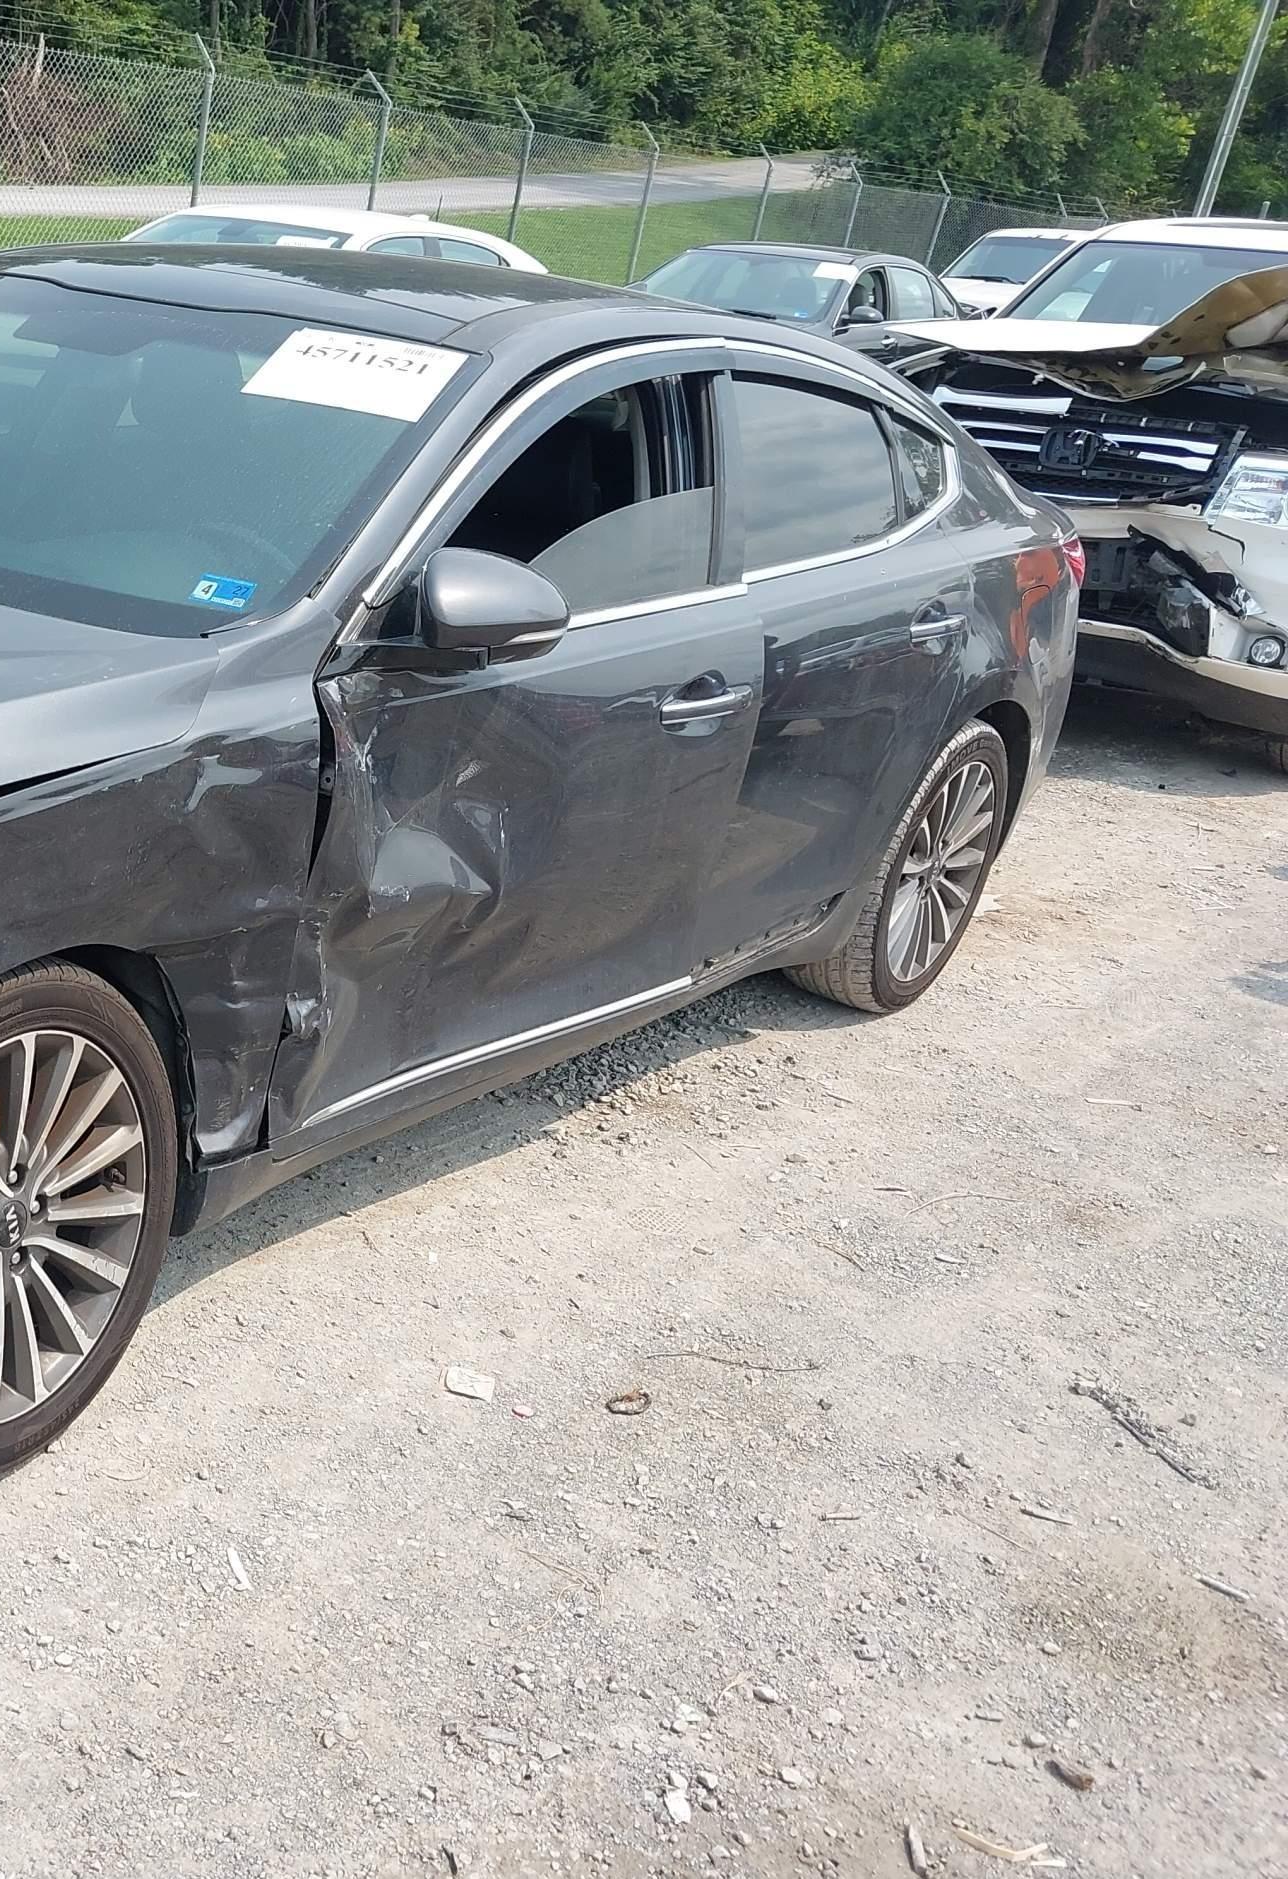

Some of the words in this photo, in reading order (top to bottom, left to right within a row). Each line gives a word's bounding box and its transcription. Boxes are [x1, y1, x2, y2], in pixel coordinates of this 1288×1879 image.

[296, 344, 429, 375] 45711521
[201, 584, 214, 596] 4
[232, 585, 250, 596] 27
[6, 1205, 21, 1245] KIA
